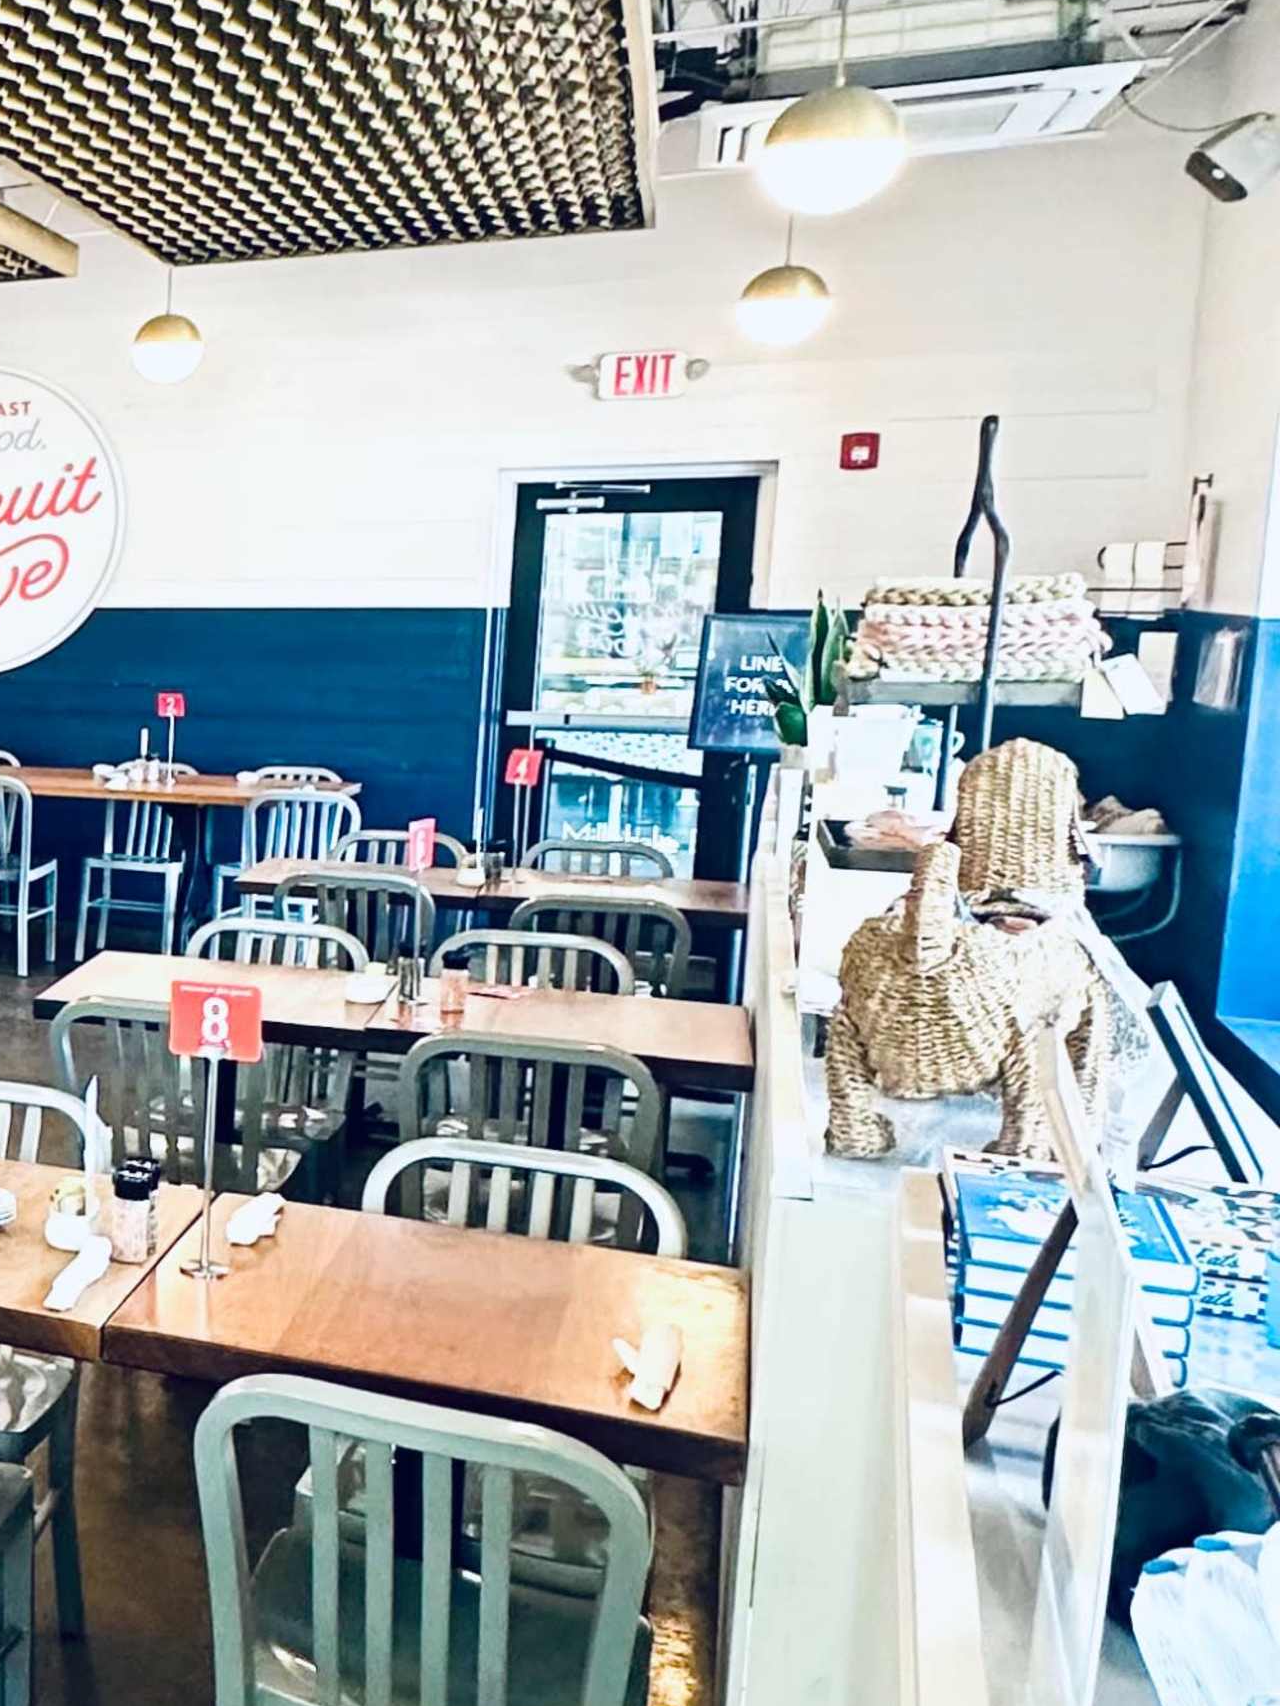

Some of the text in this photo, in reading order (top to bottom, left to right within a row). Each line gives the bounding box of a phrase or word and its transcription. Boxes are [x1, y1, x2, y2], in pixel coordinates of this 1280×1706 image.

[613, 354, 676, 396] EXIT
[739, 654, 784, 673] LINE
[165, 696, 177, 715] 2
[201, 996, 229, 1043] 8
